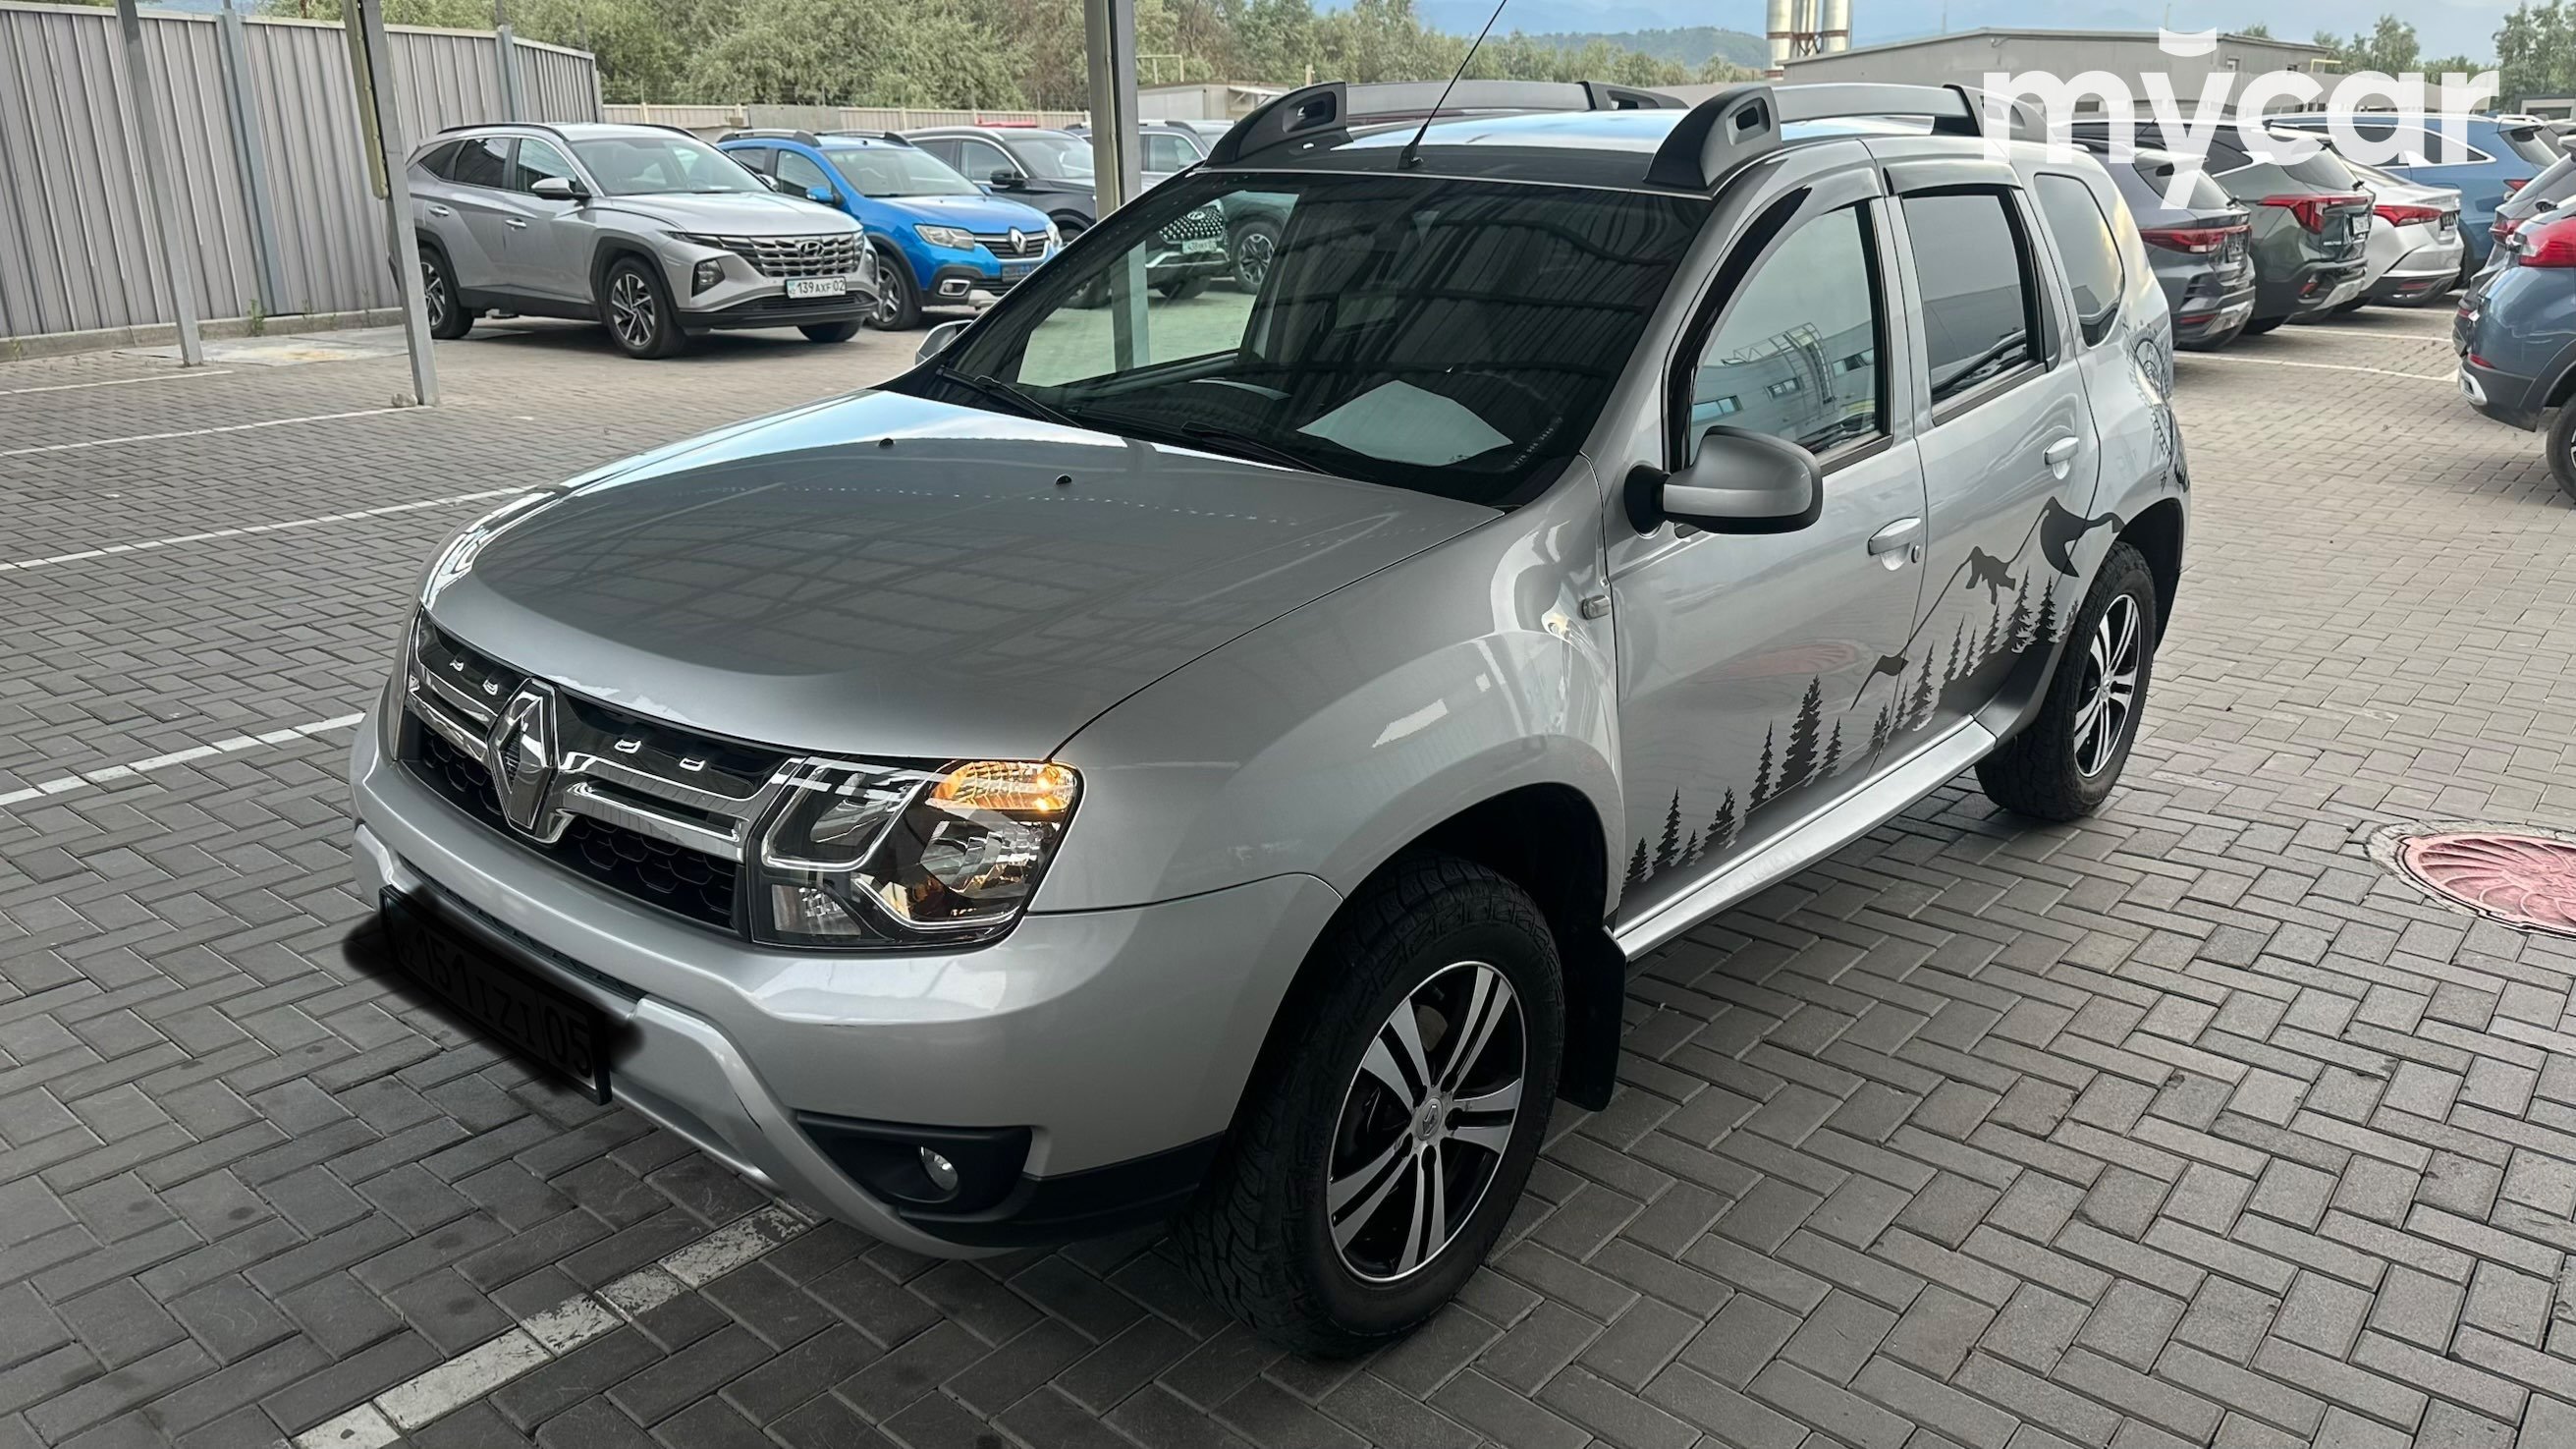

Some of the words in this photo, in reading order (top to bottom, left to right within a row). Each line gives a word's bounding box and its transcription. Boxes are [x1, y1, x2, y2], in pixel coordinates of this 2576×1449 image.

[797, 281, 814, 294] 139
[815, 283, 832, 293] AXF
[833, 279, 845, 292] 02
